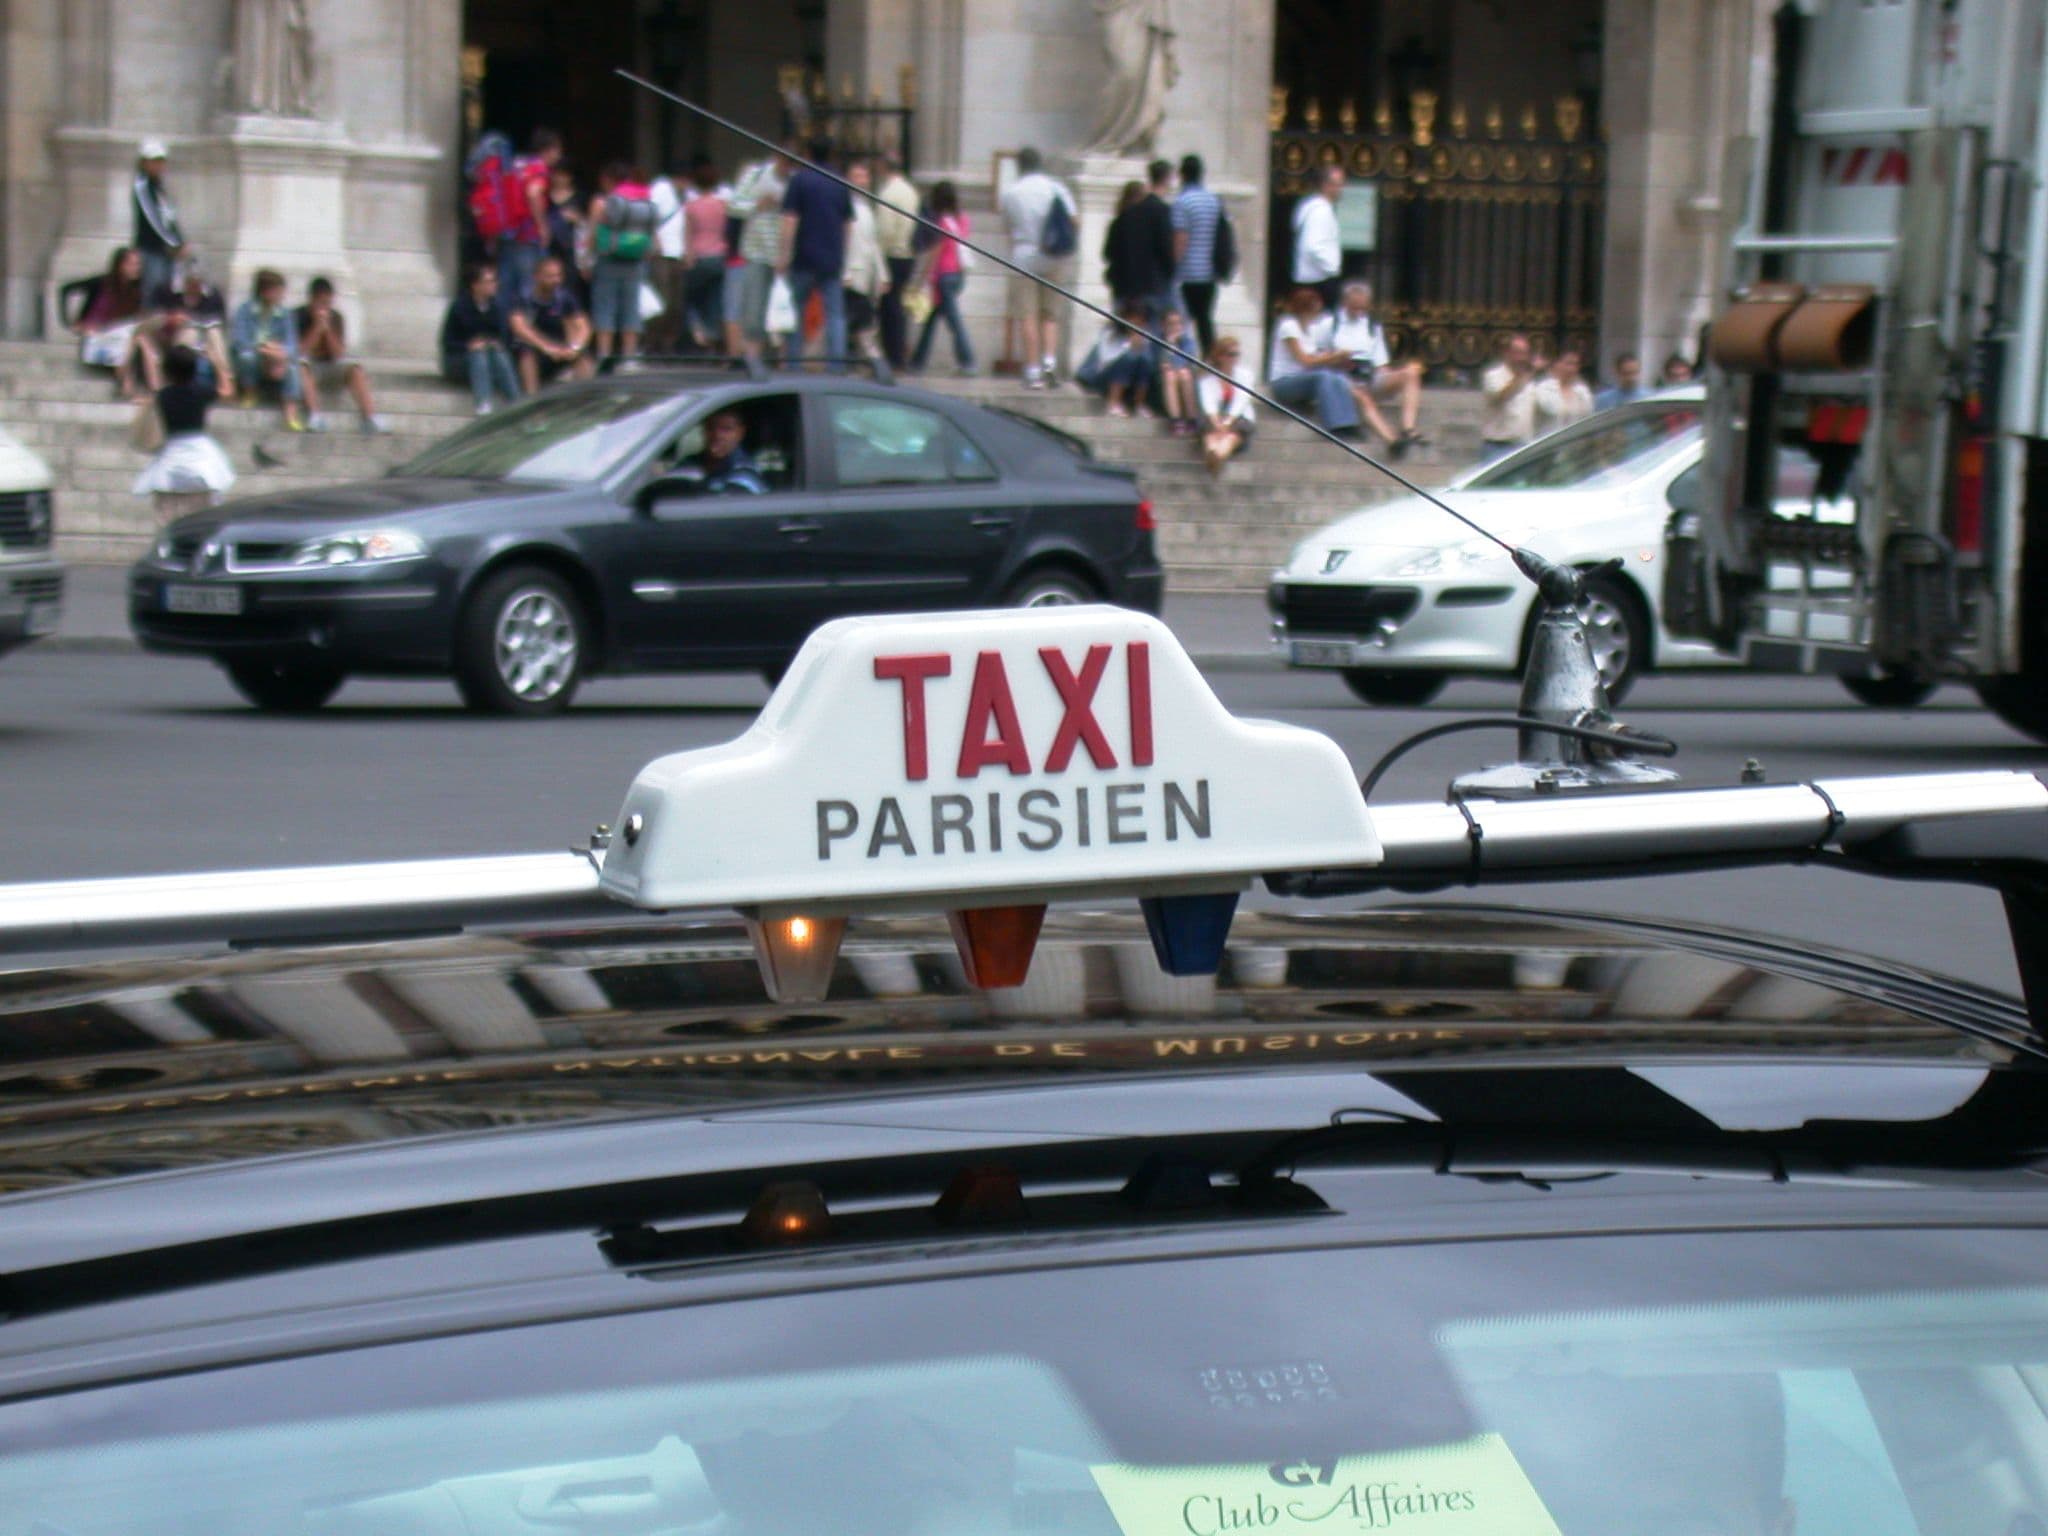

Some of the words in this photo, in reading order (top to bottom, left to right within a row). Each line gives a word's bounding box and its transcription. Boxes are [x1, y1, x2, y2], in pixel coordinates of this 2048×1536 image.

[873, 641, 1155, 782] TAXI
[815, 779, 1212, 861] PARISIEN
[1183, 1493, 1279, 1536] Club
[1286, 1482, 1476, 1530] Affaires
